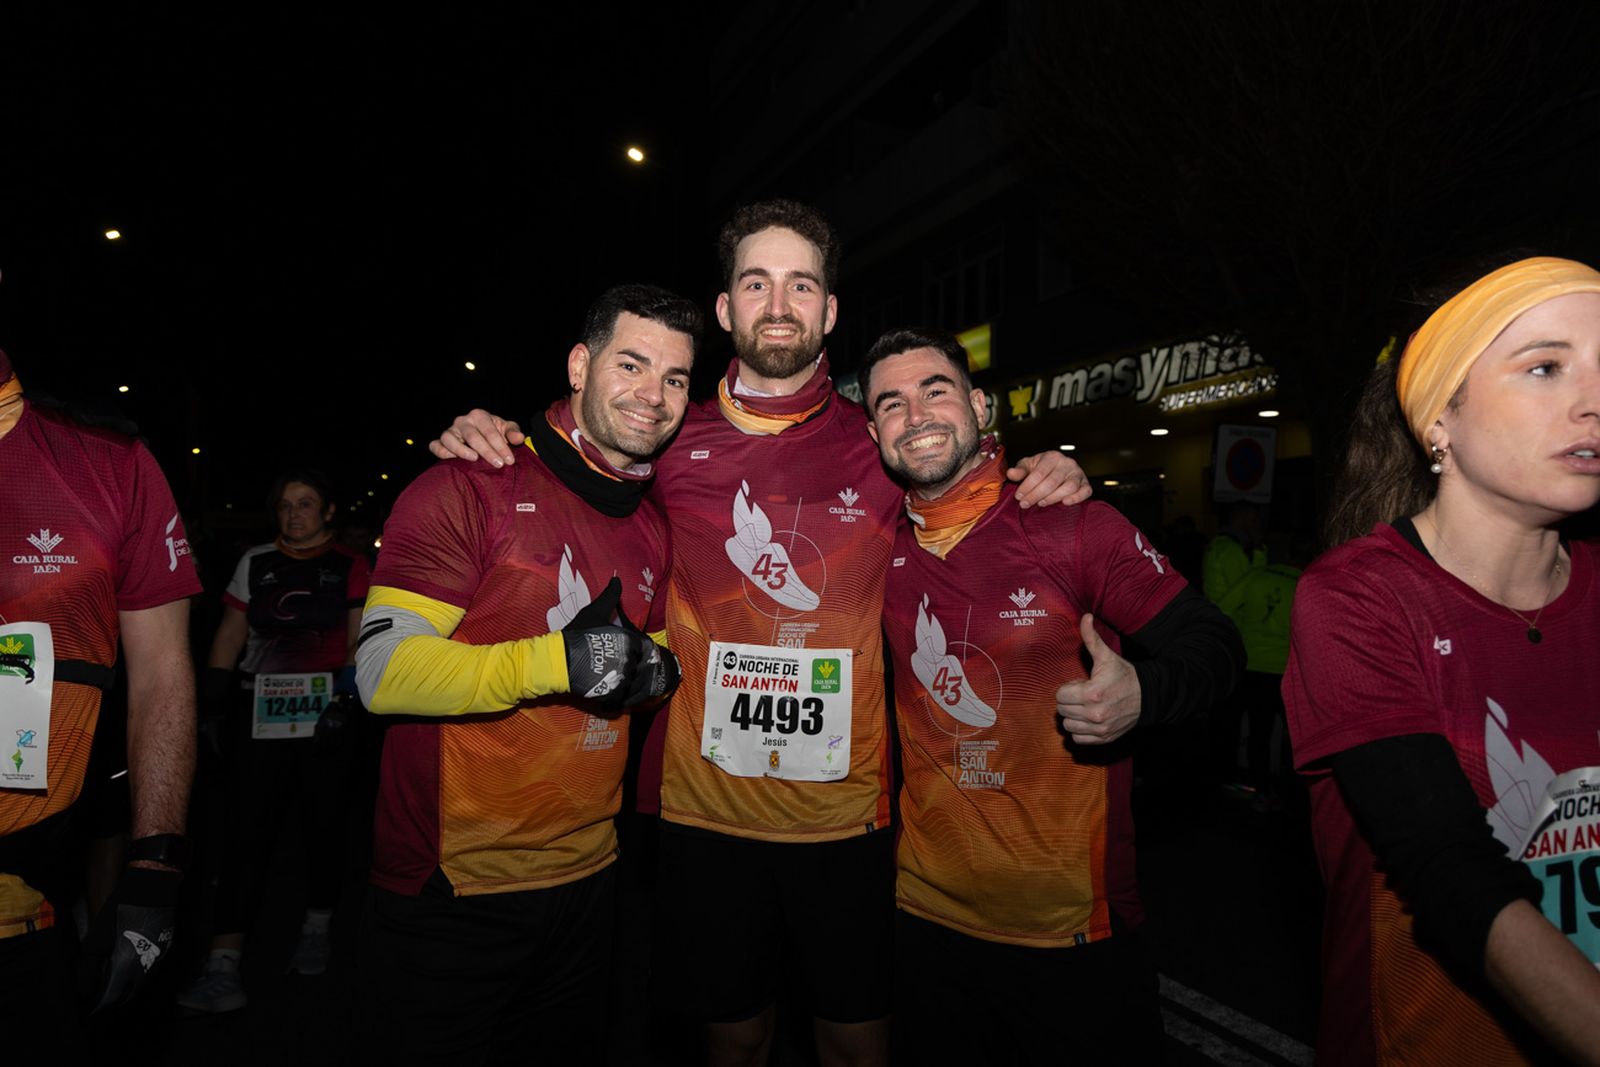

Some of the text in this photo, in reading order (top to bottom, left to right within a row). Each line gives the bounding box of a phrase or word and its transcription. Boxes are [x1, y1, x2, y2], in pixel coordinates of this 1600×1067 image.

[1048, 335, 1265, 411] masyma
[12, 555, 78, 564] CAJA RURAL
[33, 564, 60, 573] JAÉN
[752, 554, 788, 590] 43
[600, 633, 615, 658] SAN
[777, 638, 806, 649] SAN
[588, 633, 607, 675] ANTÓN
[725, 655, 737, 665] 43
[738, 660, 799, 676] NOCHE DE
[593, 681, 609, 695] 43
[721, 674, 799, 693] SAN ANTÓN
[932, 667, 963, 706] 43
[264, 696, 323, 717] 12444
[730, 693, 824, 735] 4493
[762, 736, 788, 747] Jesús
[959, 756, 987, 770] SAN
[958, 768, 1006, 785] ANTÓN
[1524, 829, 1567, 860] SAN
